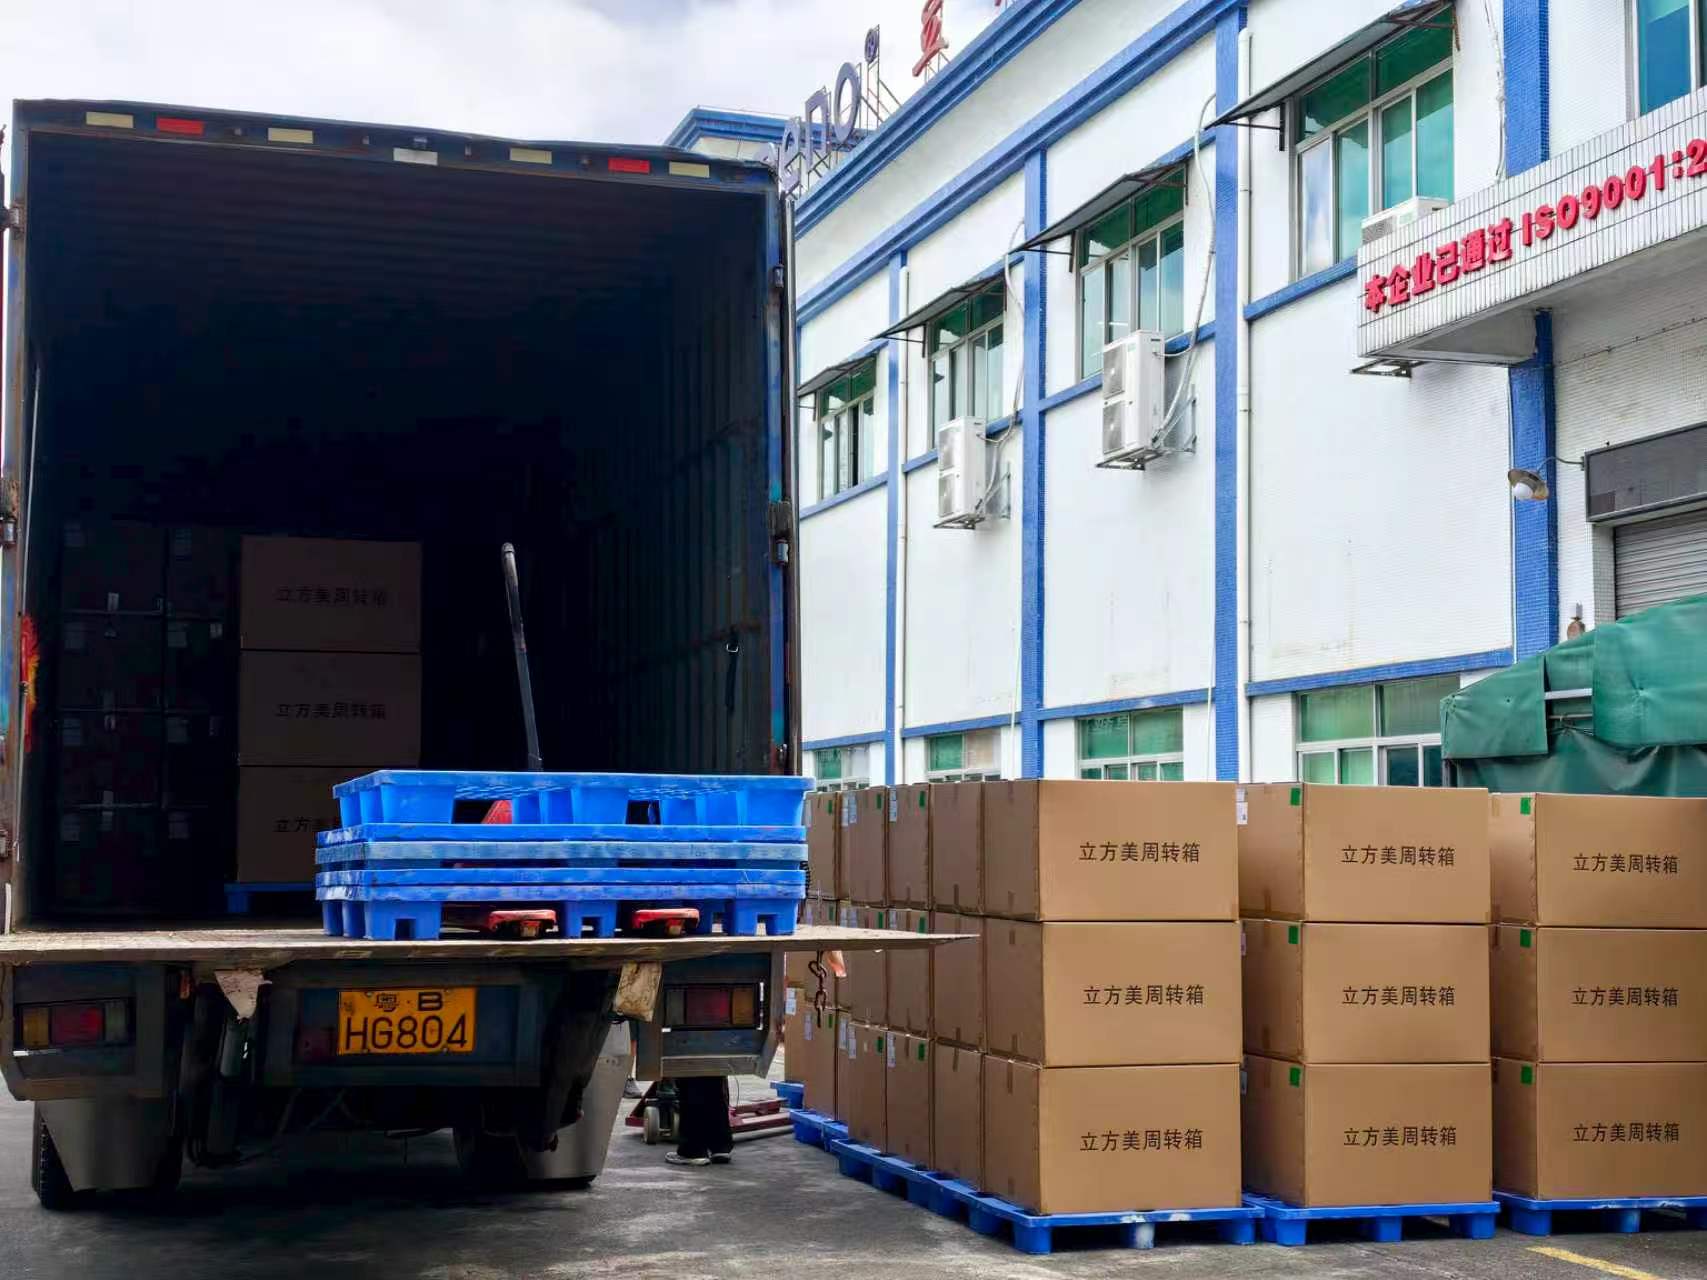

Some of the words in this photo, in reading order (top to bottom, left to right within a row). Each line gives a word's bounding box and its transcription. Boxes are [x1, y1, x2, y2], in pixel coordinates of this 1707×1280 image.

[1079, 841, 1201, 864] 立方美周转箱
[1341, 845, 1456, 868] 立方美周转箱
[1573, 852, 1680, 875] 立方美周转箱
[418, 991, 444, 1012] B
[1083, 984, 1205, 1006] 立方美周转箱
[1342, 985, 1456, 1008] 立方美周转箱
[1572, 986, 1679, 1008] 立方美周转箱
[346, 1014, 468, 1050] HG804
[1080, 1128, 1204, 1152] 立方美周转箱
[1343, 1126, 1457, 1148] 立方美周转箱
[1573, 1122, 1680, 1144] 立方美周转箱
